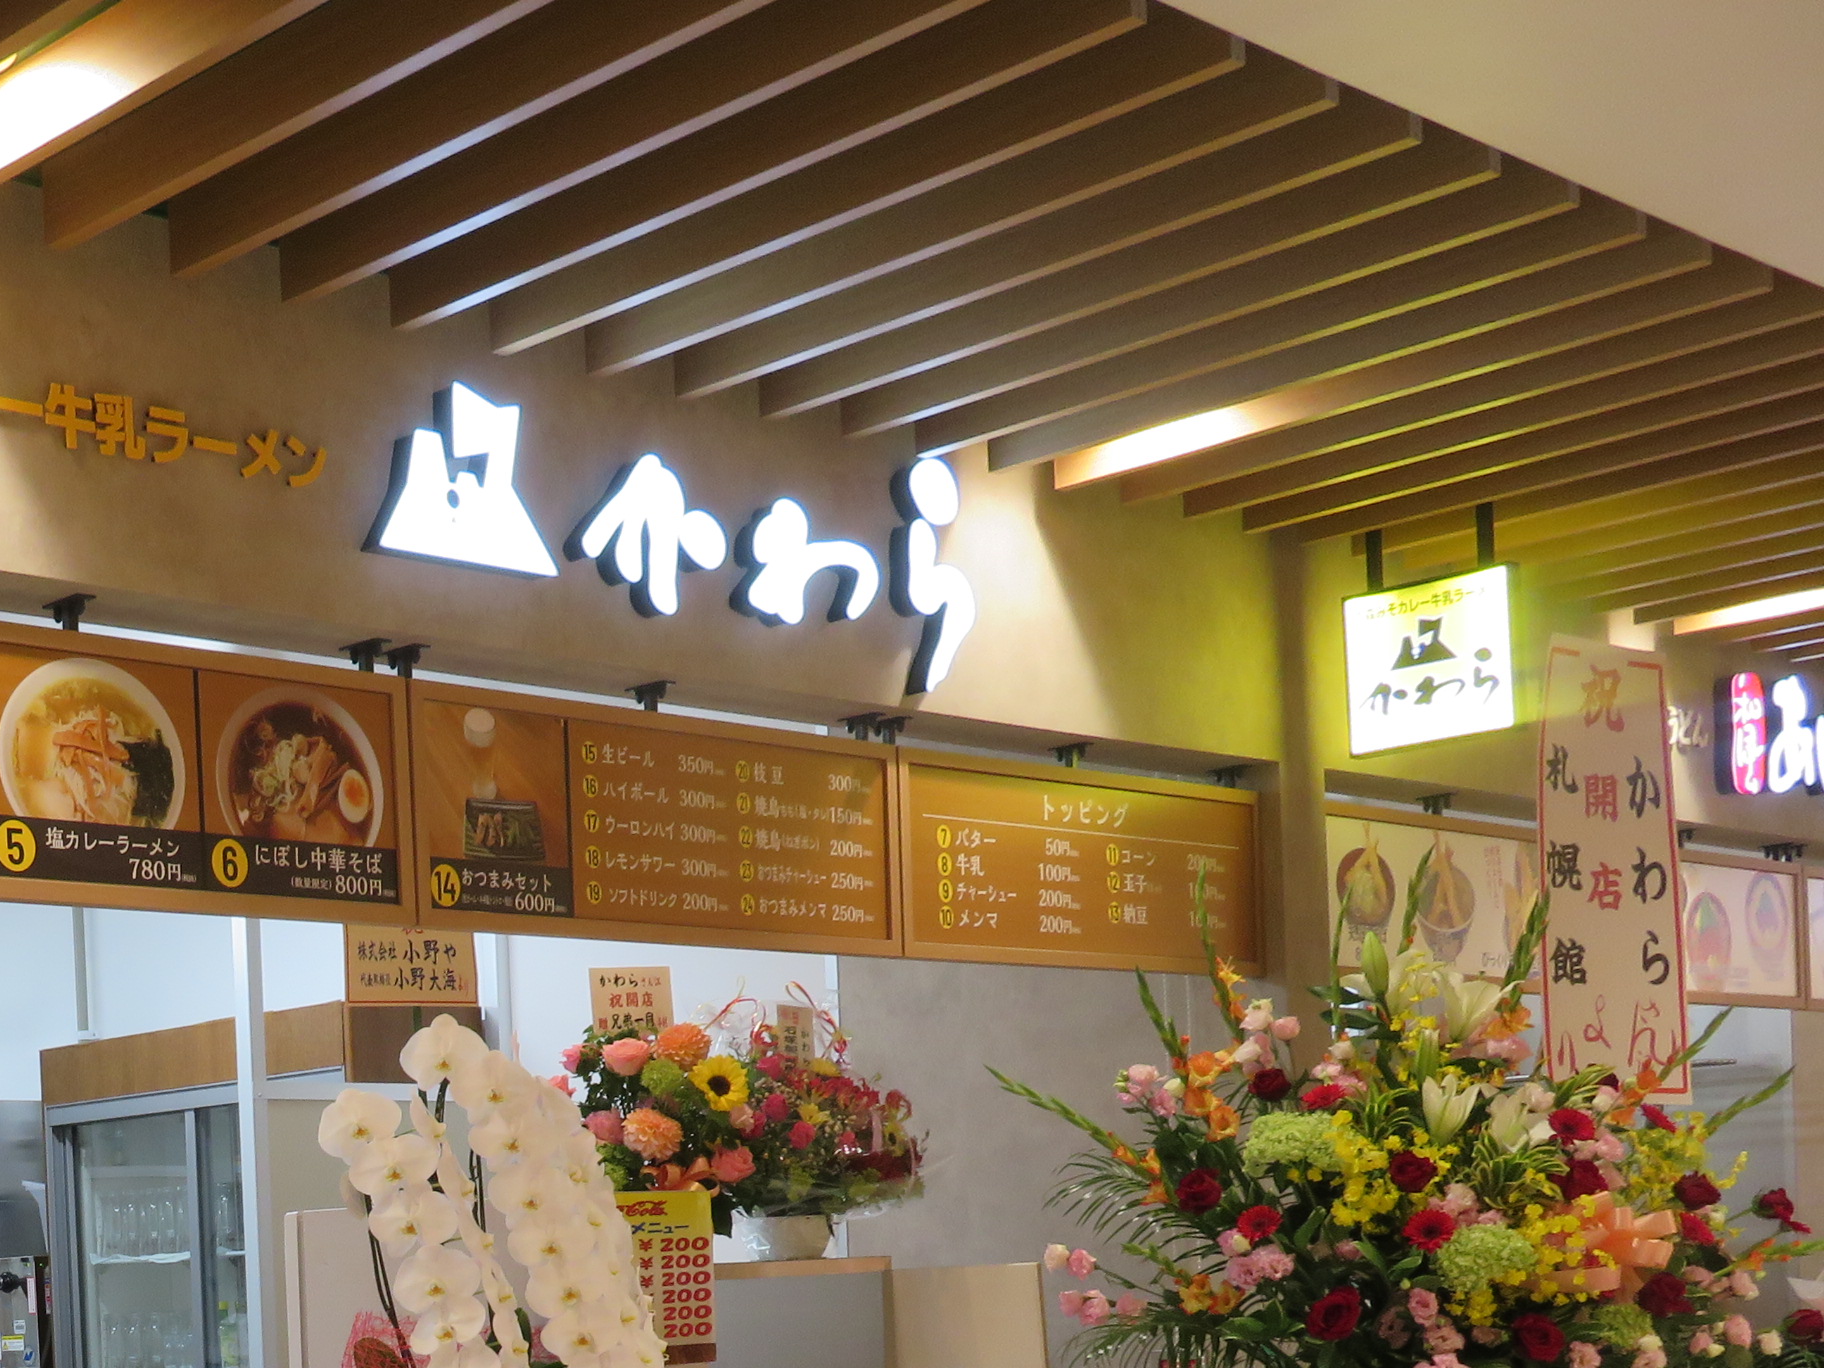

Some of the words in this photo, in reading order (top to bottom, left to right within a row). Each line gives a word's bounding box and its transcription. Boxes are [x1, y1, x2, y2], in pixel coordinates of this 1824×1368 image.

[572, 452, 976, 693] かわら
[1359, 647, 1501, 716] かわら
[602, 743, 655, 768] 生ビール
[678, 754, 715, 776] 350円
[753, 762, 785, 785] 枝豆
[827, 773, 861, 793] 300円
[1579, 663, 1625, 912] 祝開店
[603, 781, 670, 804] ハイボール
[678, 789, 716, 810] 300円
[830, 806, 862, 826] 150円
[1042, 794, 1129, 829] トッピング
[605, 814, 676, 841] ウーロンハイ
[680, 823, 716, 844] 300円
[955, 827, 997, 848] バター
[1045, 837, 1070, 857] 50円
[5, 827, 25, 866] 5
[45, 826, 181, 858] 塩カレーラーメン
[829, 839, 863, 858] 200円
[1121, 849, 1156, 867] コーン
[128, 857, 182, 882] 780円
[221, 845, 239, 882] 6
[254, 843, 383, 875] にぼし中華そば
[605, 851, 676, 873] レモンサワー
[681, 857, 717, 879] 300円
[955, 852, 985, 877] 牛乳
[1037, 862, 1071, 882] 100円
[1544, 742, 1589, 988] 札幌館
[1626, 756, 1672, 987] かわら
[290, 876, 333, 892] (数量限定)
[334, 875, 383, 898] 800円
[432, 868, 458, 904] 14
[460, 867, 553, 892] おつまみセット
[831, 872, 864, 891] 250円
[514, 892, 556, 914] 600円
[609, 887, 678, 908] ソフトドリンク
[682, 892, 718, 913] 200円
[956, 882, 1017, 903] チャーシュー
[1038, 889, 1072, 909] 200円
[759, 896, 827, 919] おつまみメンマ
[832, 904, 864, 924] 250円
[958, 909, 998, 929] メンマ
[1039, 914, 1073, 935] 200円
[357, 941, 398, 962] 株式会社
[403, 938, 457, 965] 小野や
[393, 966, 457, 992] 小野大海
[599, 972, 639, 988] かわら
[608, 991, 654, 1009] 祝開店
[632, 1222, 690, 1235] メニュー
[659, 1236, 711, 1252] 200
[660, 1253, 711, 1270] 200
[661, 1270, 712, 1287] 200
[662, 1287, 713, 1304] 200
[662, 1304, 713, 1321] 200
[663, 1321, 714, 1339] 200
